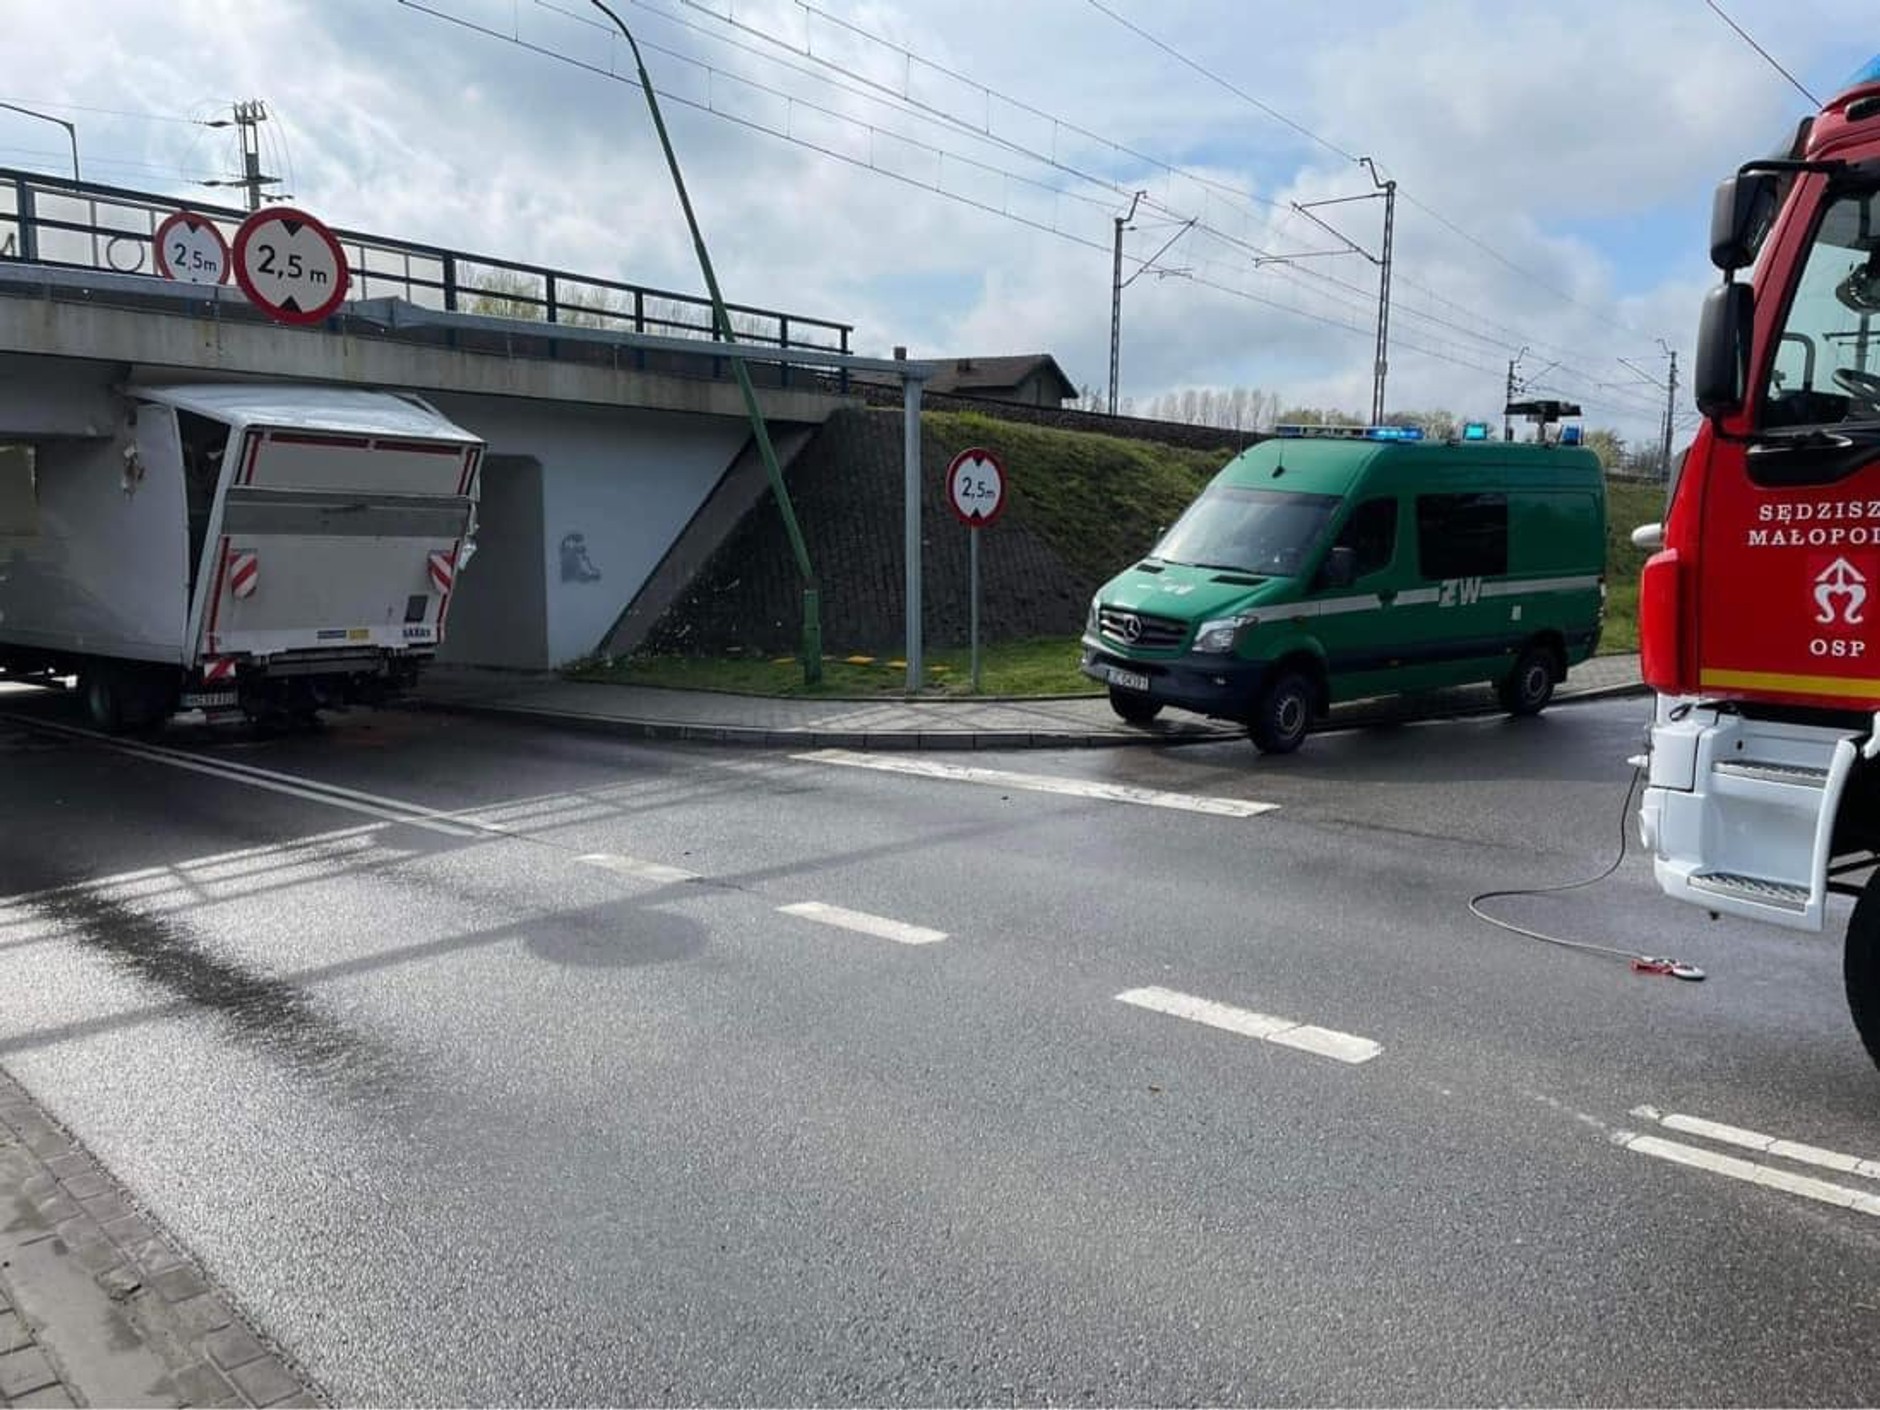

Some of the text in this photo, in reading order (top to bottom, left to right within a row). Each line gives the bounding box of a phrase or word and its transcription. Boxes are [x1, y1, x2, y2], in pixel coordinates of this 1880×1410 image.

[257, 244, 327, 285] 2,5 m
[1759, 501, 1880, 525] SĘDZISZ
[1809, 638, 1866, 657] OSP
